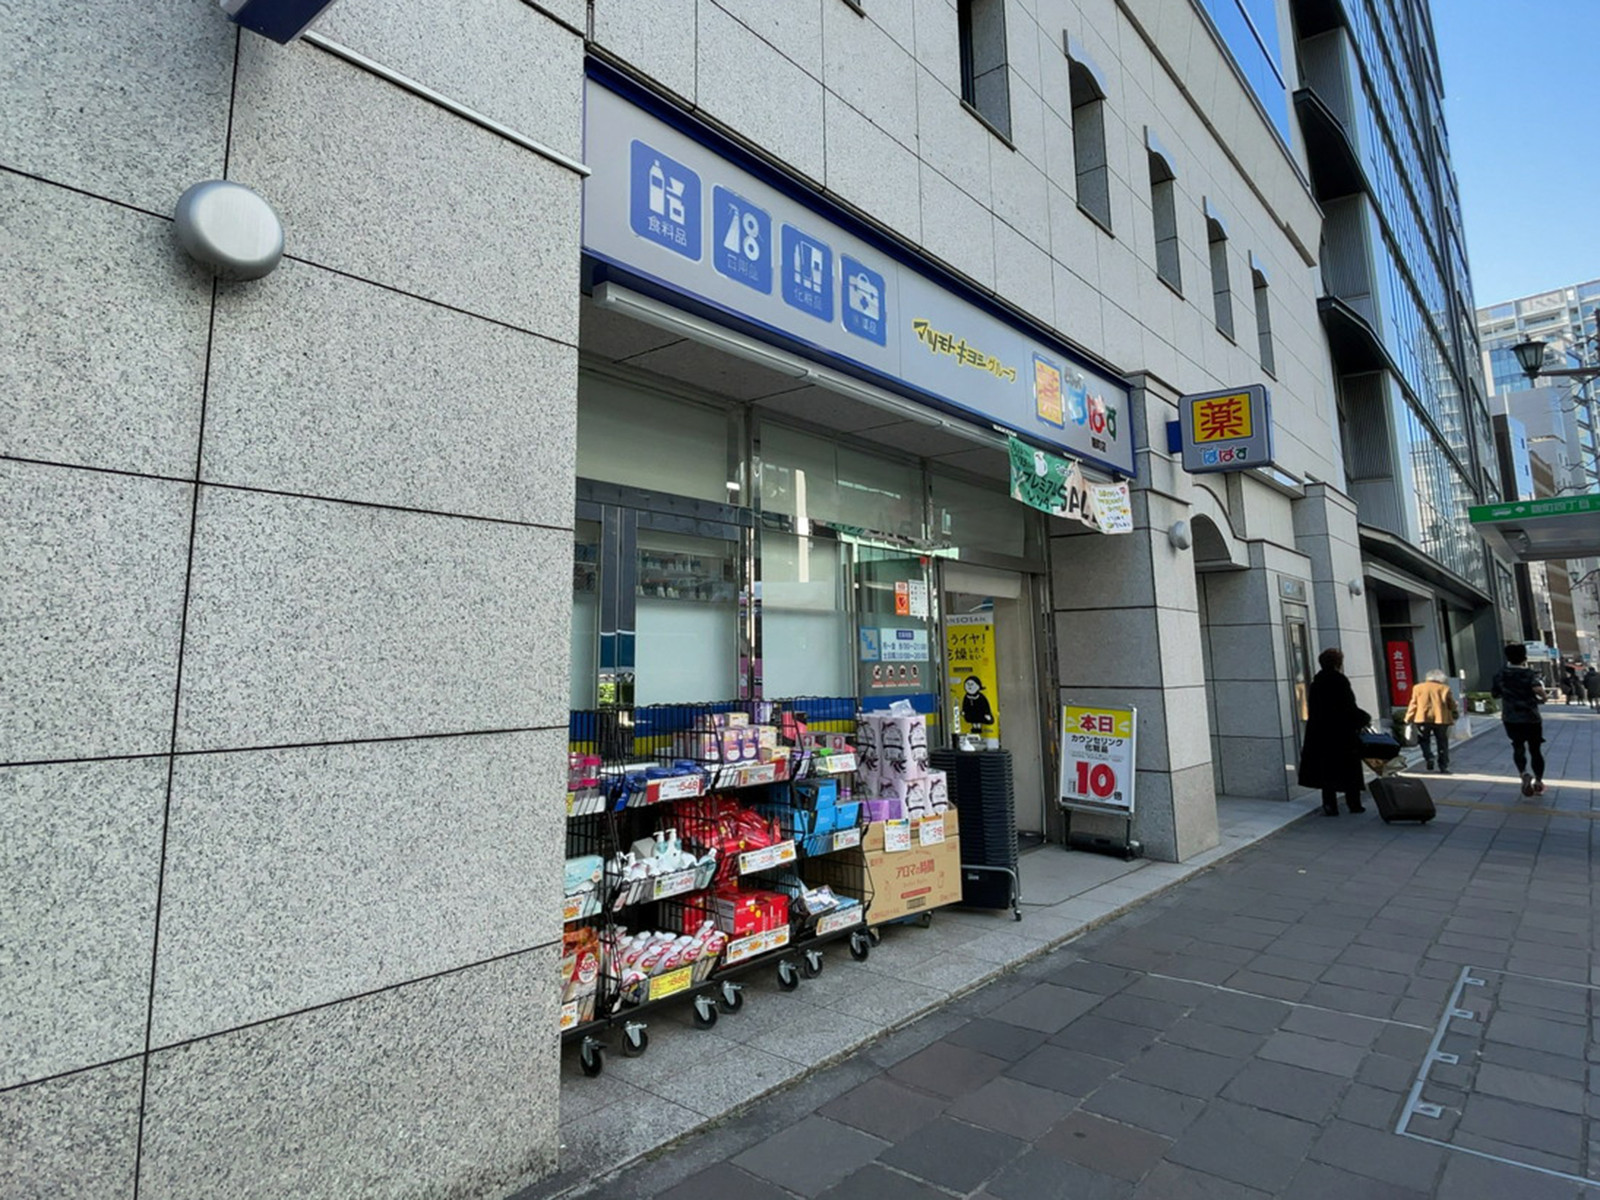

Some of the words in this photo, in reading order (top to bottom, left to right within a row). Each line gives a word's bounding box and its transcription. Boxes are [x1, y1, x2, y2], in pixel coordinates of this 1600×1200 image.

[647, 214, 688, 247] 食料品
[1199, 397, 1244, 440] 薬
[1058, 484, 1097, 522] SAL
[1071, 734, 1124, 747] カウンセリング
[1080, 714, 1114, 734] 本日
[1075, 760, 1116, 798] 10
